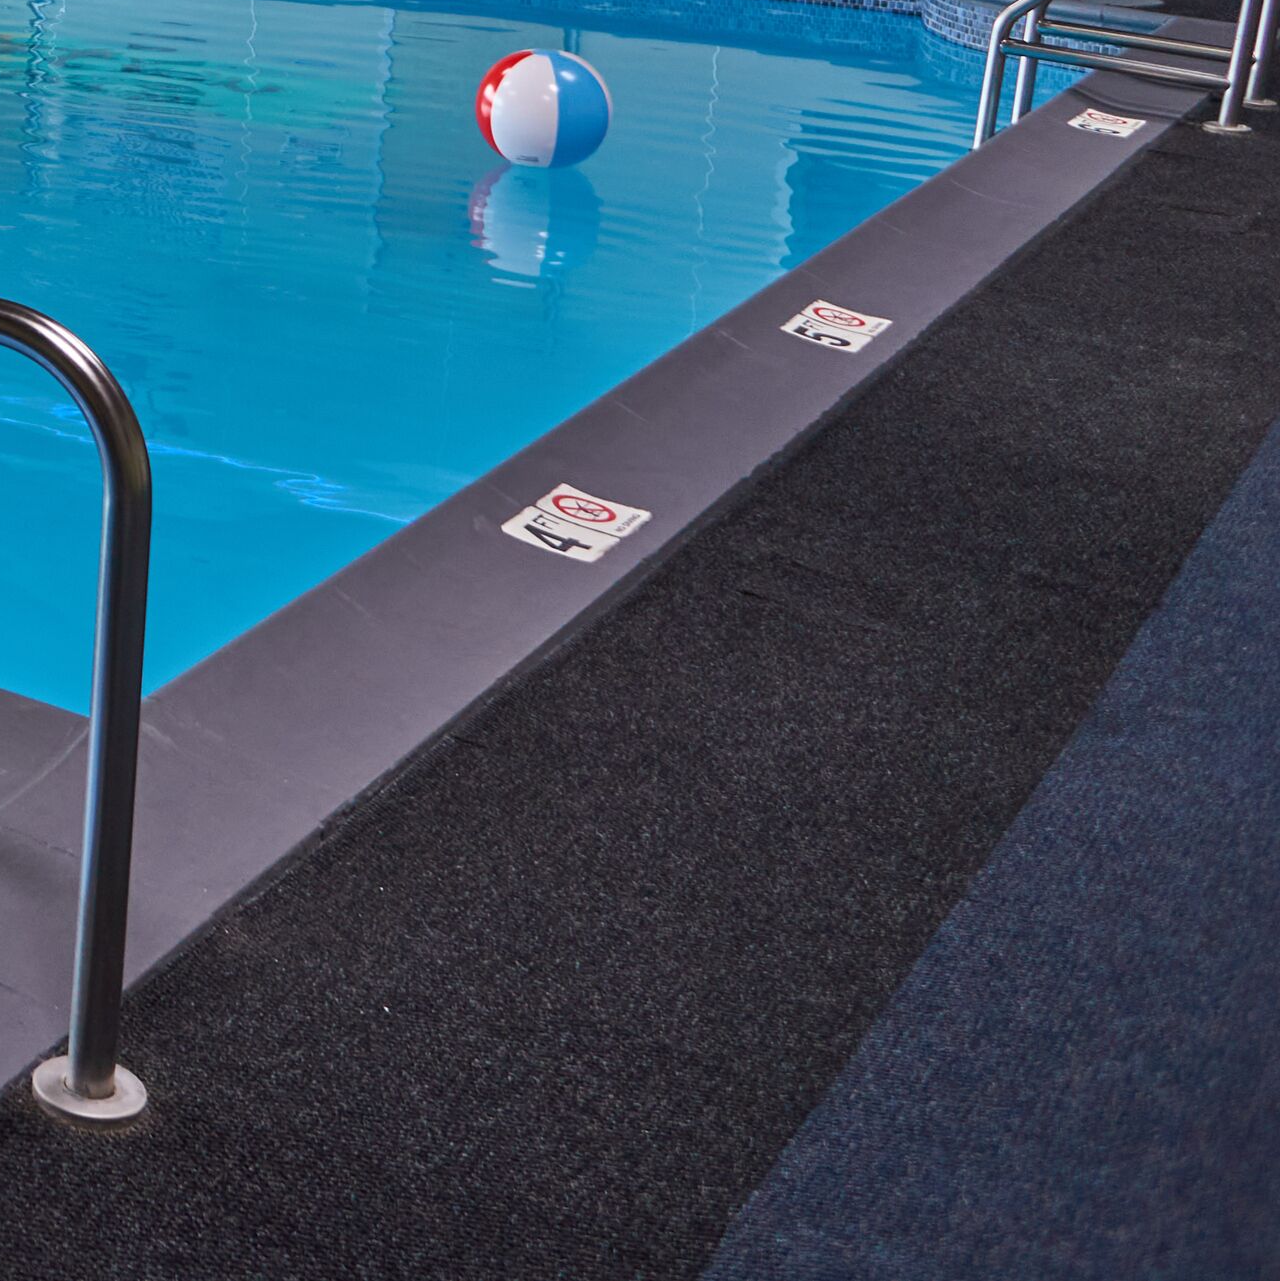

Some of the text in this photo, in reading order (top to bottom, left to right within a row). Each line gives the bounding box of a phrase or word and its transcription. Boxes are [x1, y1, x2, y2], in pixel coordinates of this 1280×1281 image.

[793, 326, 851, 346] 5
[524, 514, 592, 552] 4 FT
